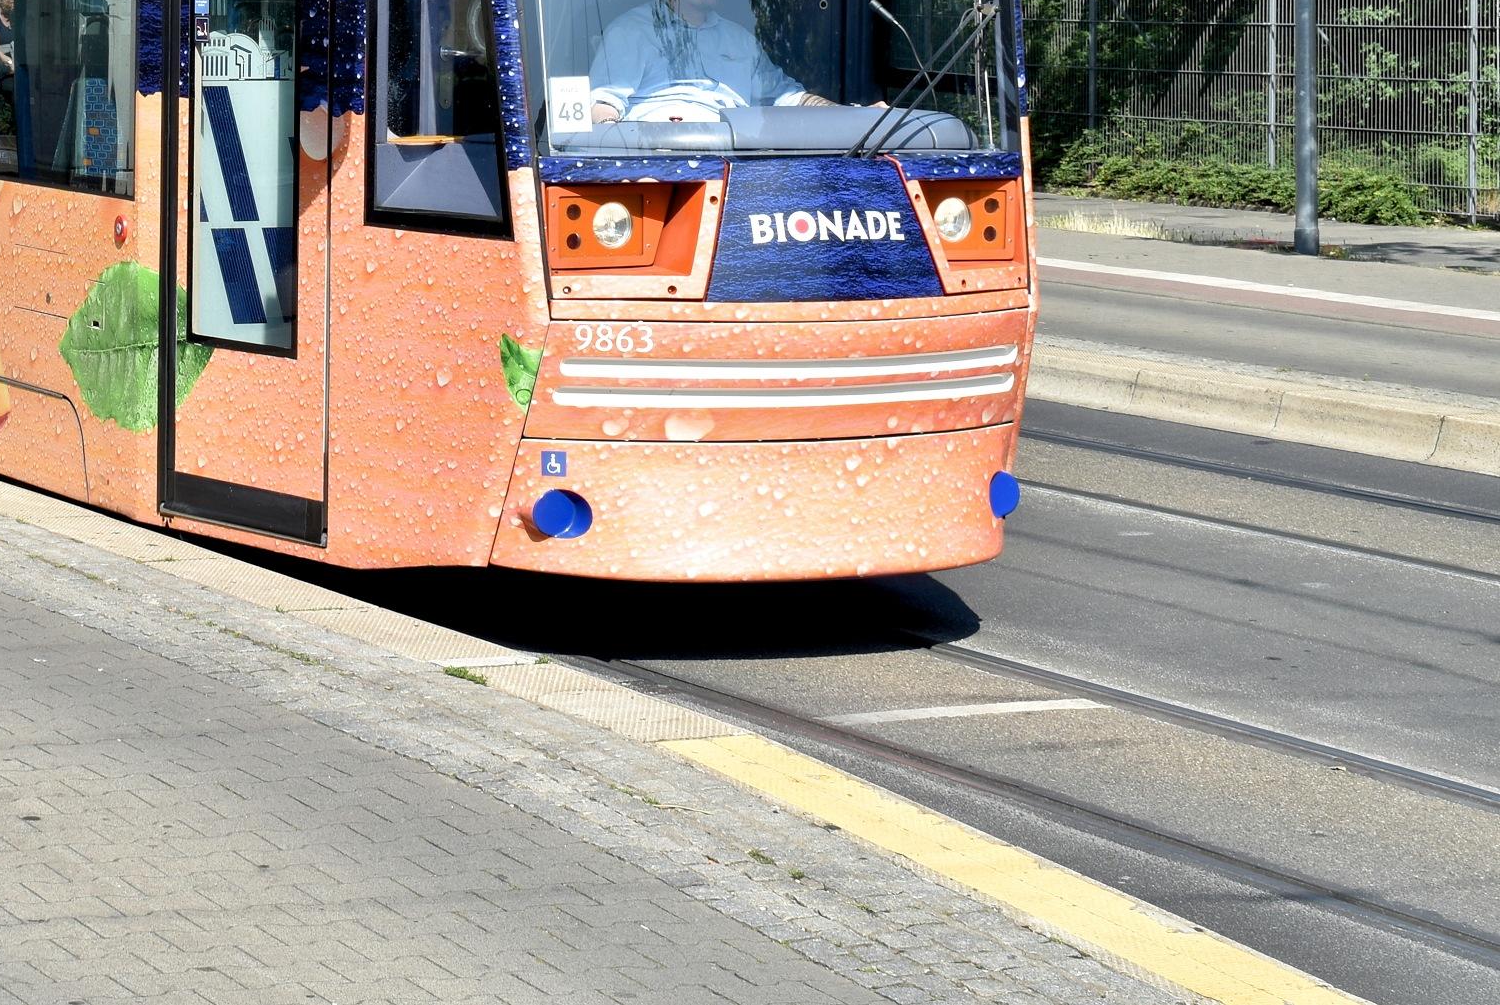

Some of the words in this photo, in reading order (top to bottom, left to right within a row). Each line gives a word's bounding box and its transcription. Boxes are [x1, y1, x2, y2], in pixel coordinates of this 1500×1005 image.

[558, 102, 584, 121] 48
[748, 210, 906, 245] BIONADE
[574, 324, 654, 353] 9863
